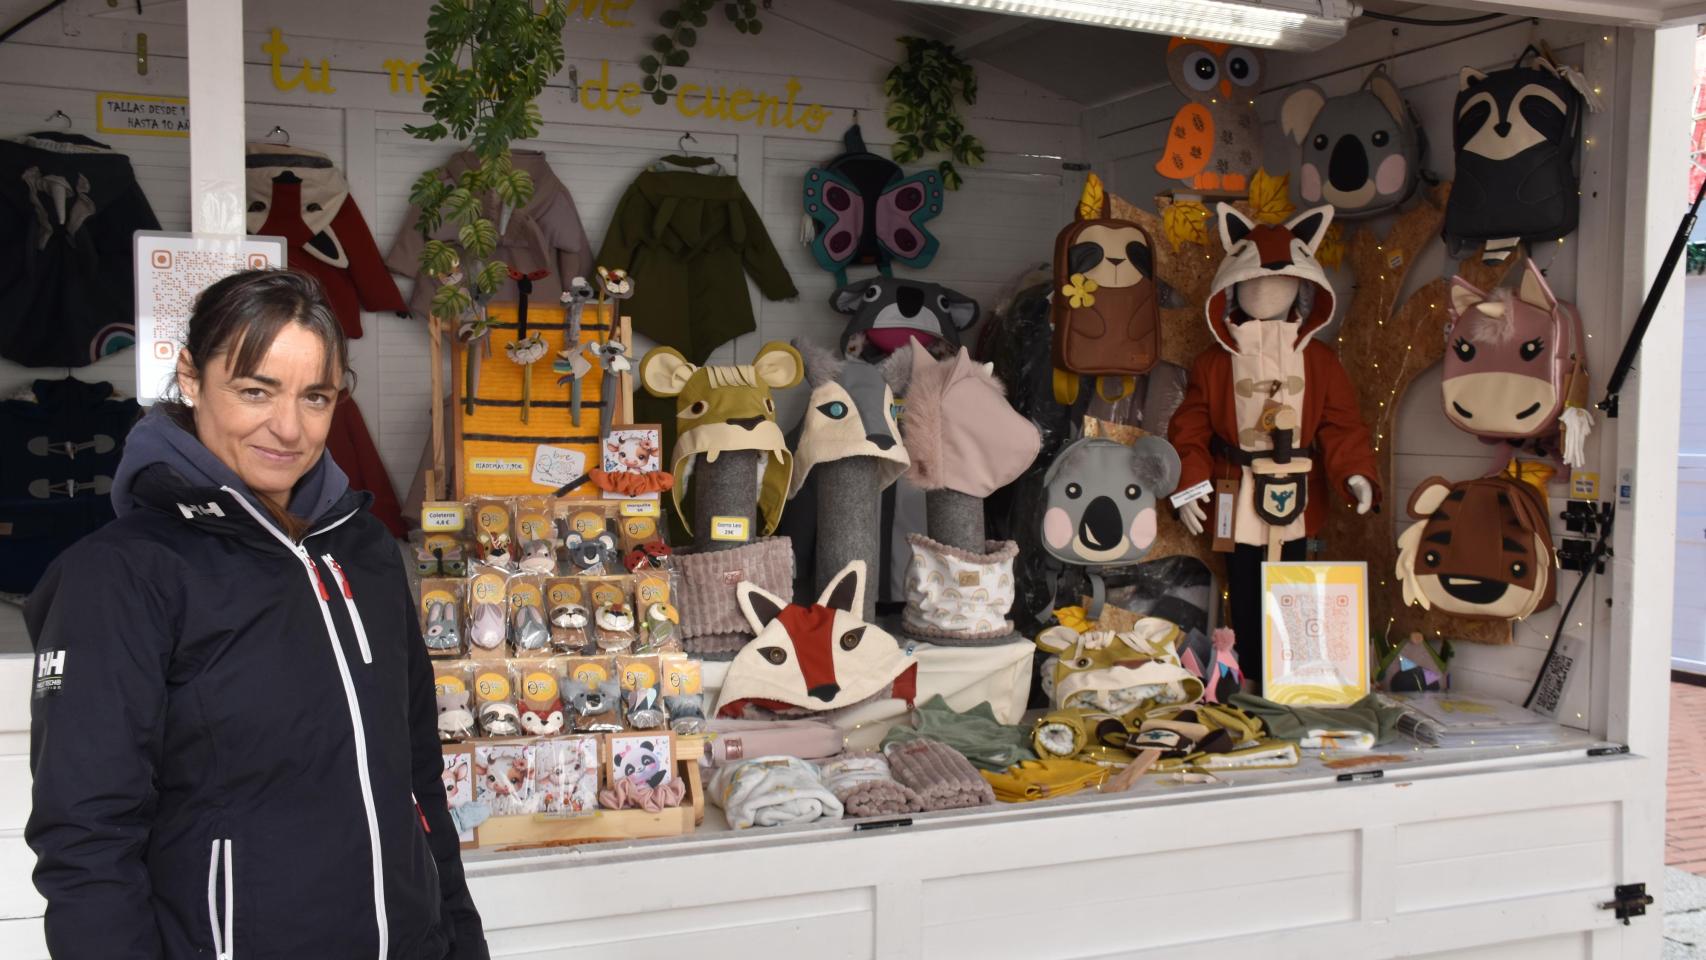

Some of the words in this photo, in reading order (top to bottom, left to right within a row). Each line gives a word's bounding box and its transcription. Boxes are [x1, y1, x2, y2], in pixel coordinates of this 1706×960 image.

[262, 27, 337, 95] tu
[580, 59, 641, 116] de
[676, 77, 832, 134] cuento
[107, 101, 145, 114] TALLAS
[149, 105, 177, 115] DESDE
[128, 117, 159, 129] HASTA
[162, 120, 174, 130] 10
[177, 120, 190, 132] AÑ
[38, 650, 66, 678] HH
